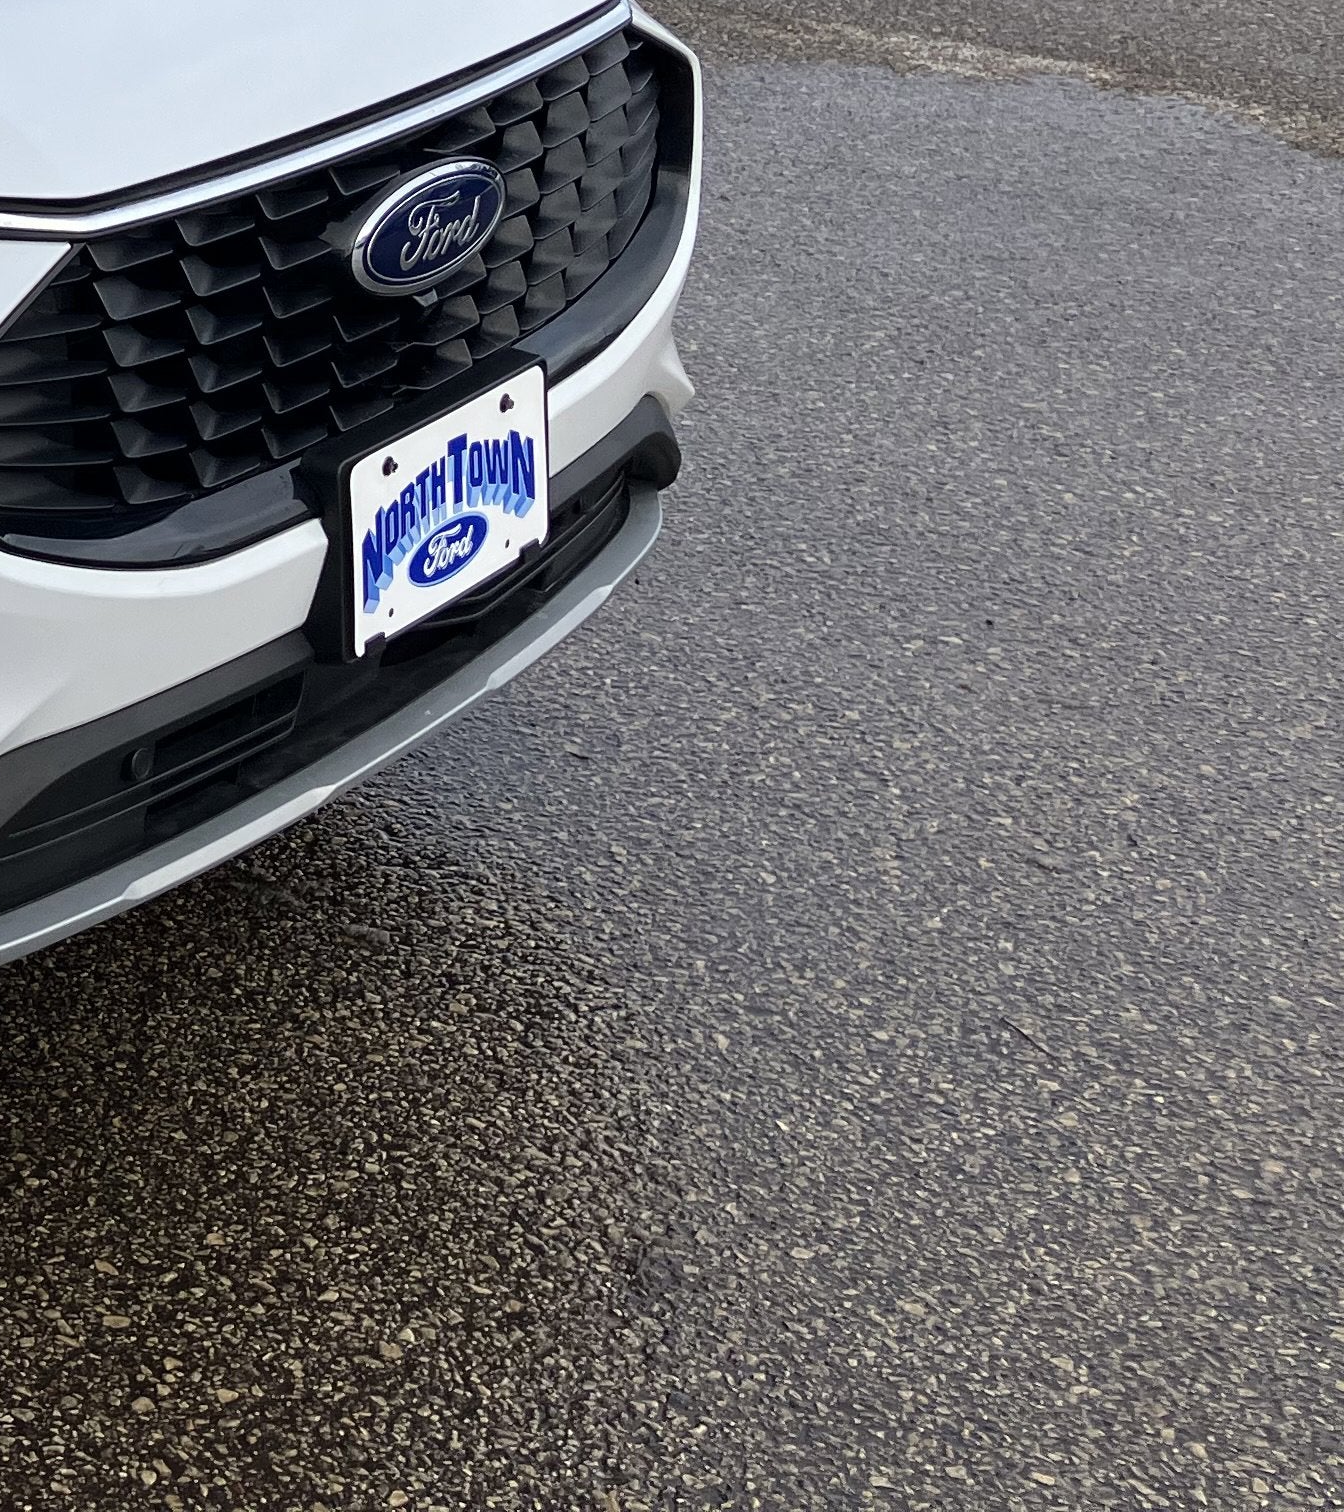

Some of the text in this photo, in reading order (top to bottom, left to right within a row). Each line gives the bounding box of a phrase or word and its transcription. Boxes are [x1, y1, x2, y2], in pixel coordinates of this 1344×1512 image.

[400, 190, 481, 272] Ford
[362, 429, 536, 614] NORTHTOWN
[423, 523, 474, 578] Ford
